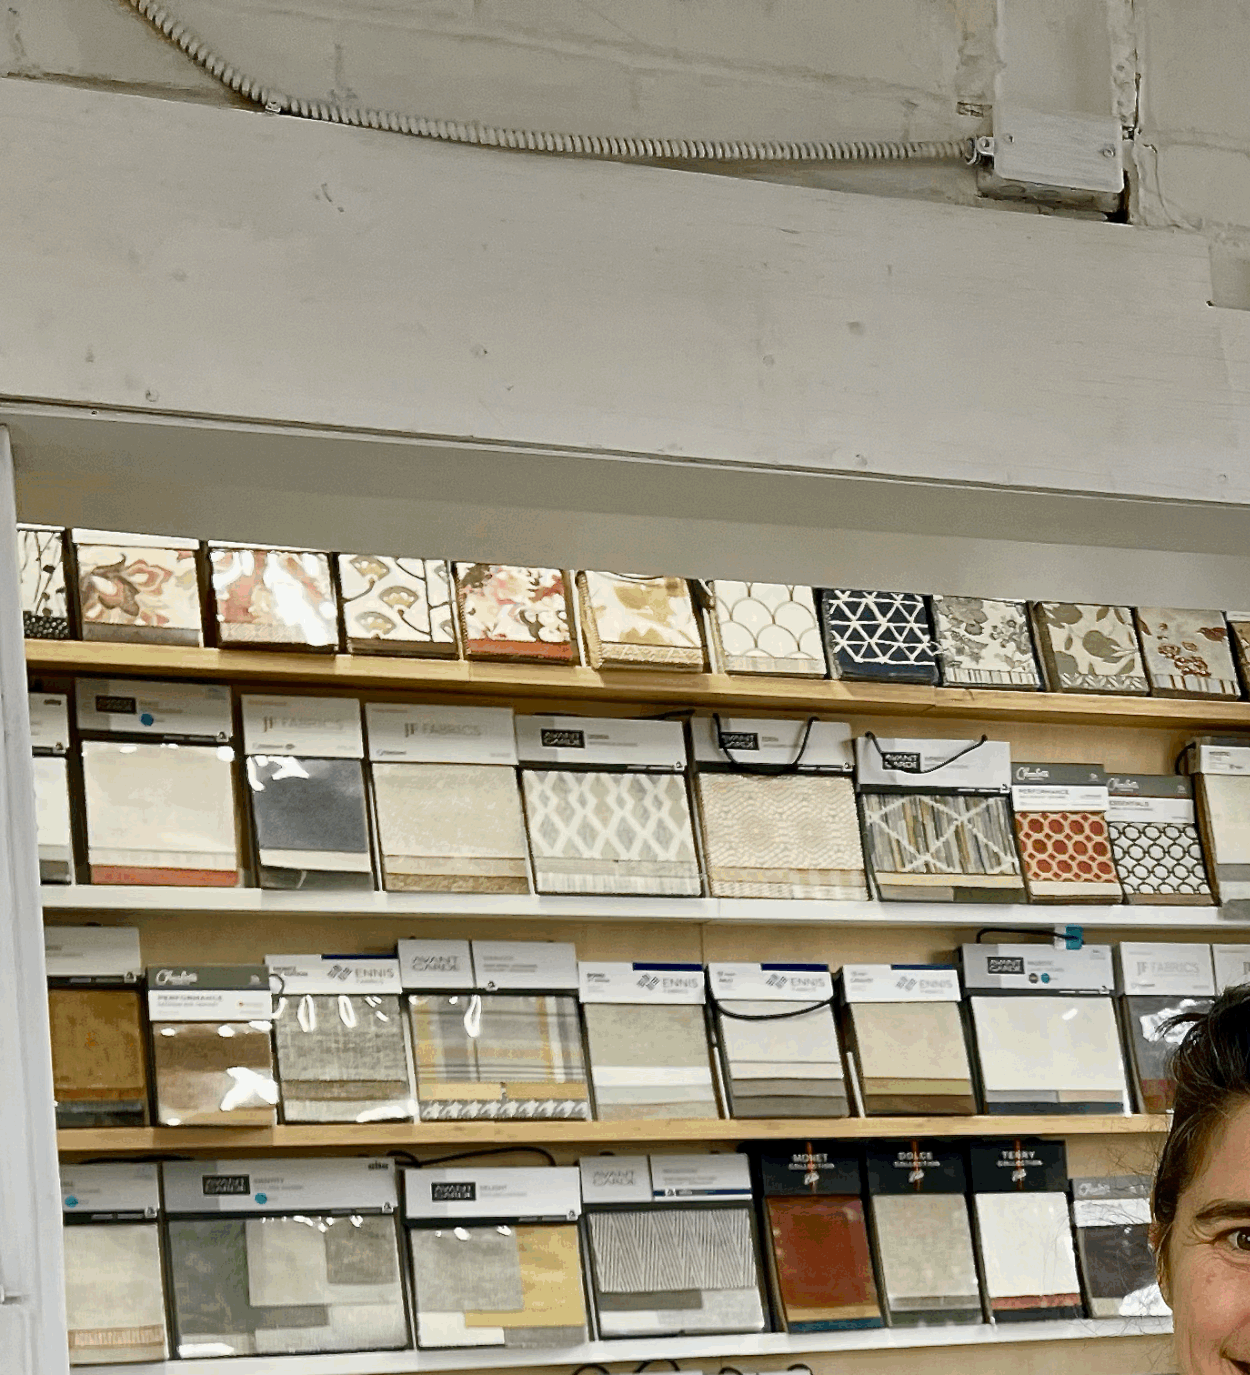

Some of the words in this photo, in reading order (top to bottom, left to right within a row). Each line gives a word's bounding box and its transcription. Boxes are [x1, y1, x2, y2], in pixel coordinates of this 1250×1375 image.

[1151, 962, 1199, 974] FABRICS
[355, 968, 395, 979] ENNIS
[662, 978, 699, 988] ENNIS
[790, 977, 826, 988] ENNIS
[792, 1153, 828, 1163] MONET
[897, 1151, 933, 1161] DOLCE
[1001, 1150, 1036, 1160] TERRY
